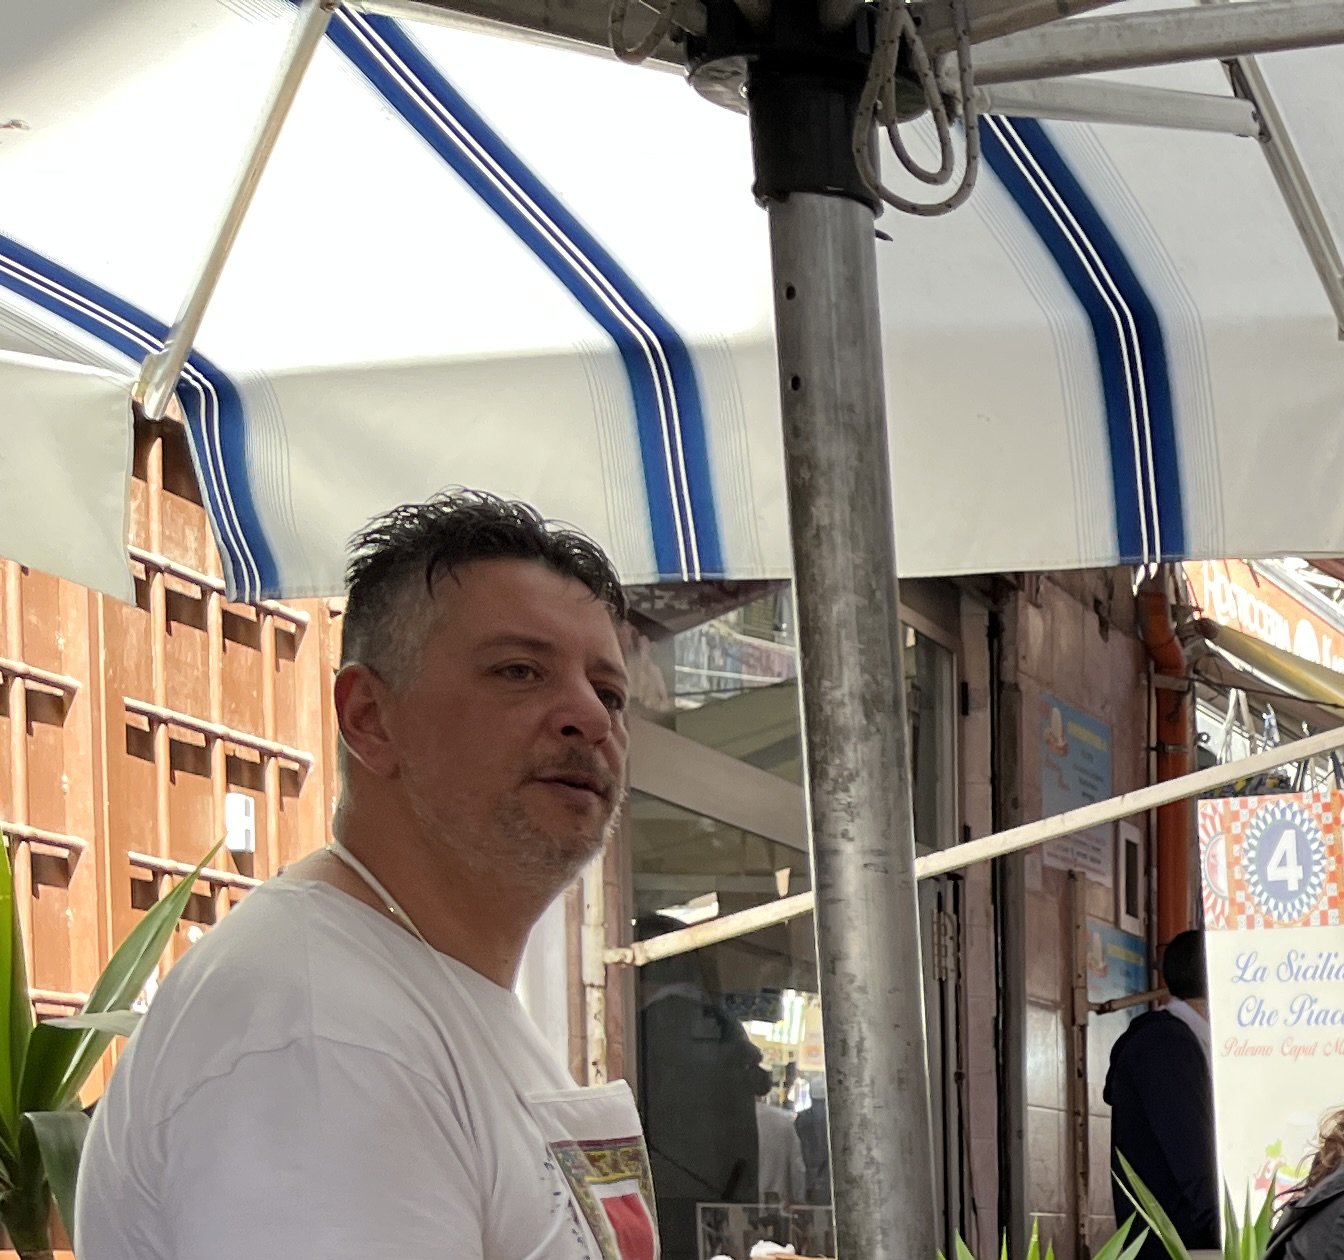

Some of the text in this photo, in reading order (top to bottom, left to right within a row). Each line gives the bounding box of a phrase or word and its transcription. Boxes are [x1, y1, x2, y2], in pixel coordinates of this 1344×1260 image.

[1266, 828, 1304, 892] 4
[1231, 950, 1269, 984] La
[1236, 995, 1280, 1028] Che
[1221, 1036, 1275, 1058] Palermo
[1280, 1036, 1318, 1062] Caput
